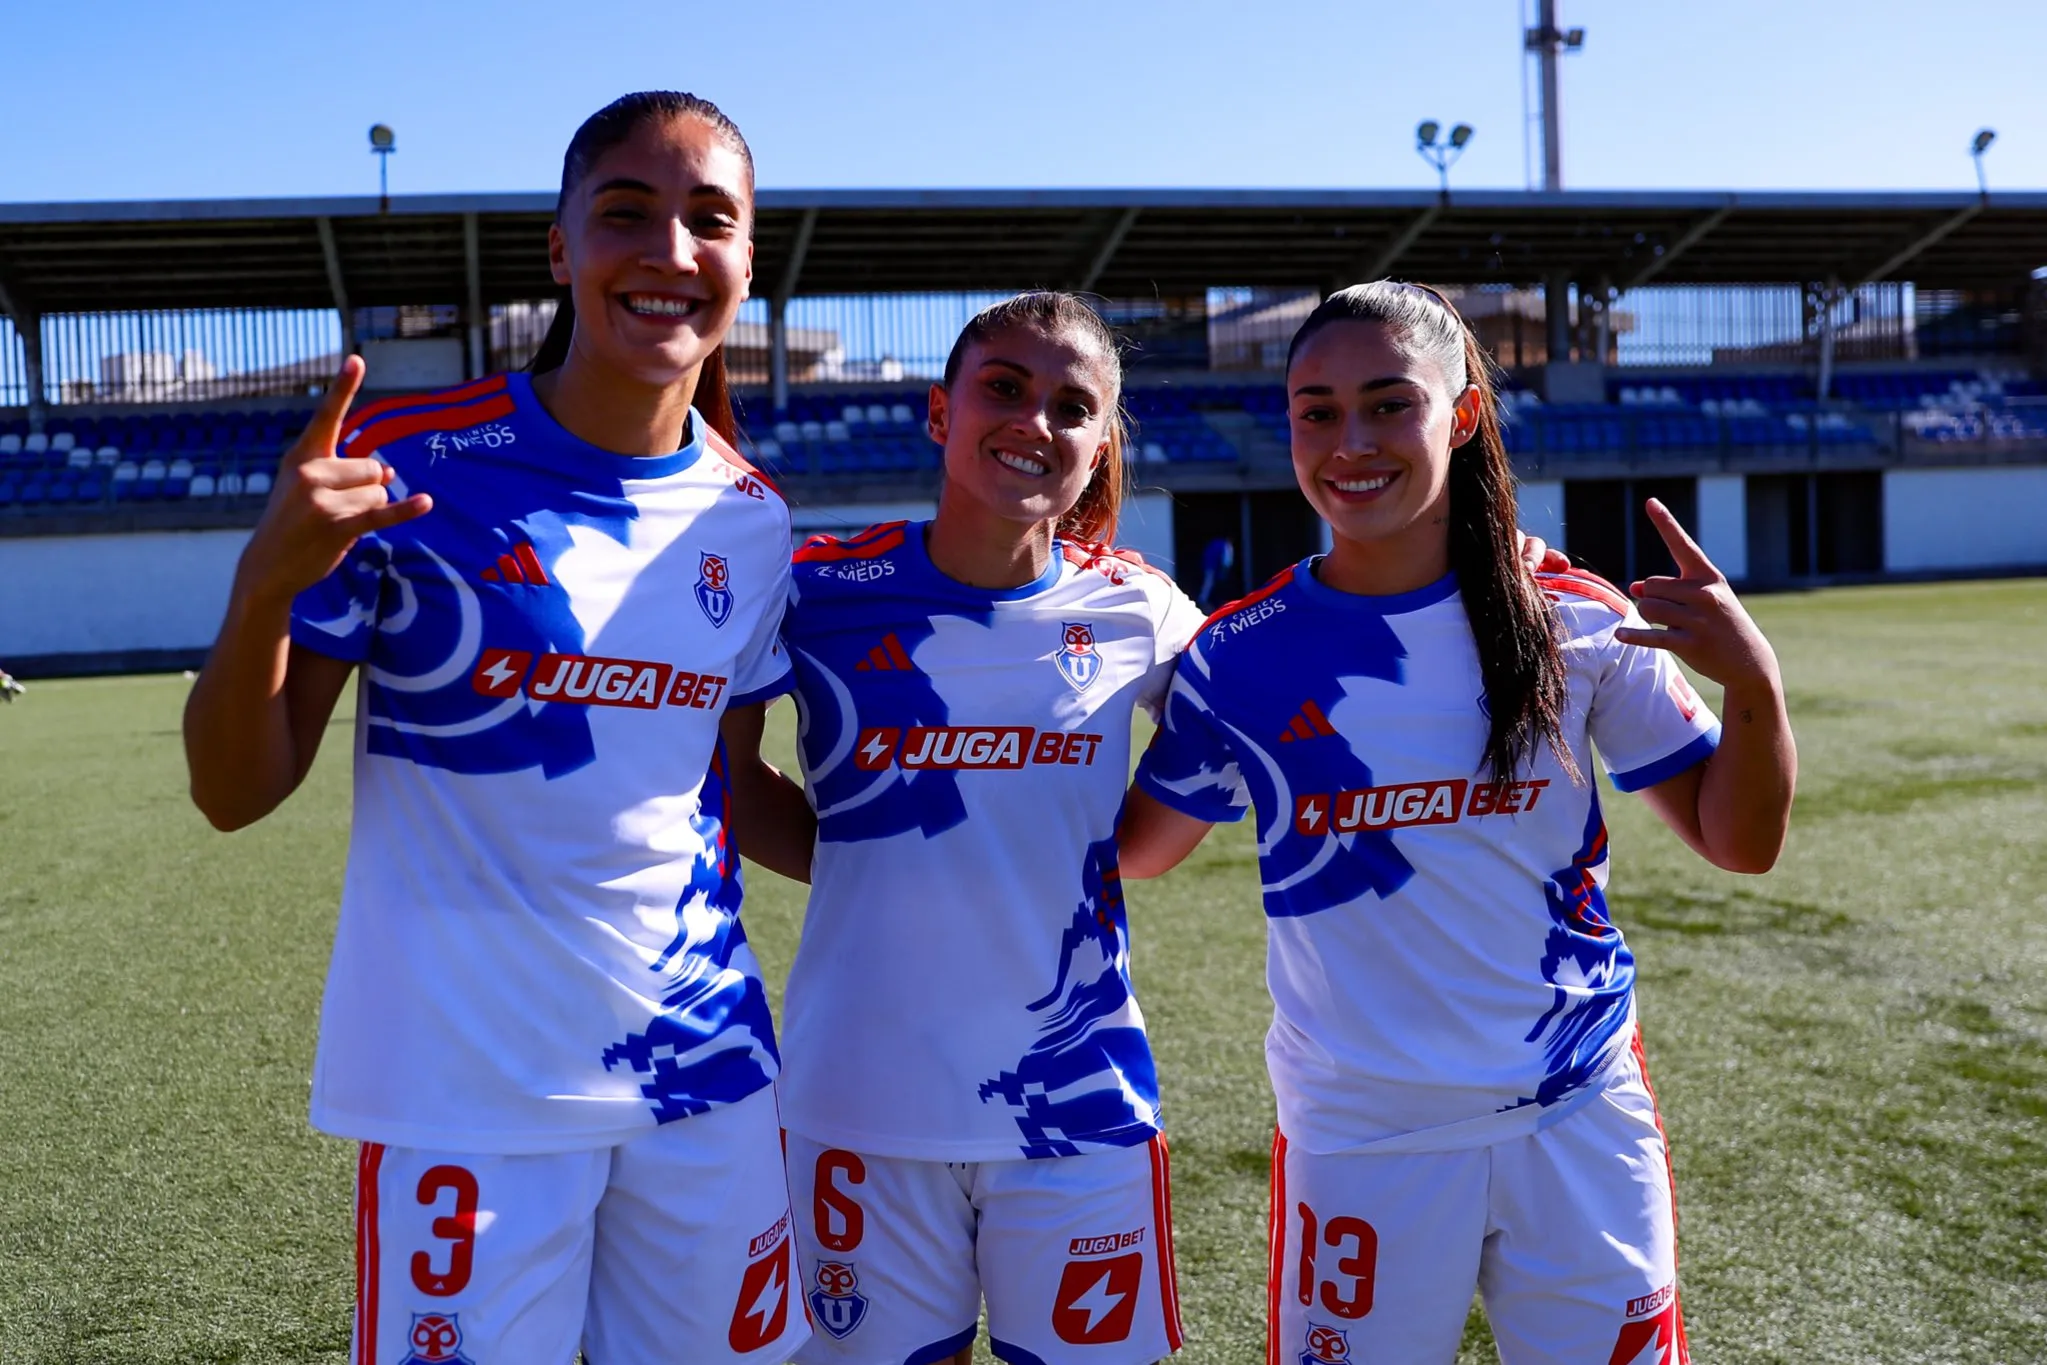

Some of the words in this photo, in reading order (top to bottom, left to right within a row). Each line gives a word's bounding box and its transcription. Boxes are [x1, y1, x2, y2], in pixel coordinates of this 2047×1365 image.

[837, 561, 895, 582] MEDS
[705, 590, 725, 619] U
[1229, 599, 1286, 634] MEDS
[1068, 656, 1091, 683] U
[813, 1149, 866, 1252] 6
[411, 1165, 479, 1296] 3
[1298, 1201, 1378, 1319] 13
[822, 1298, 853, 1329] U
